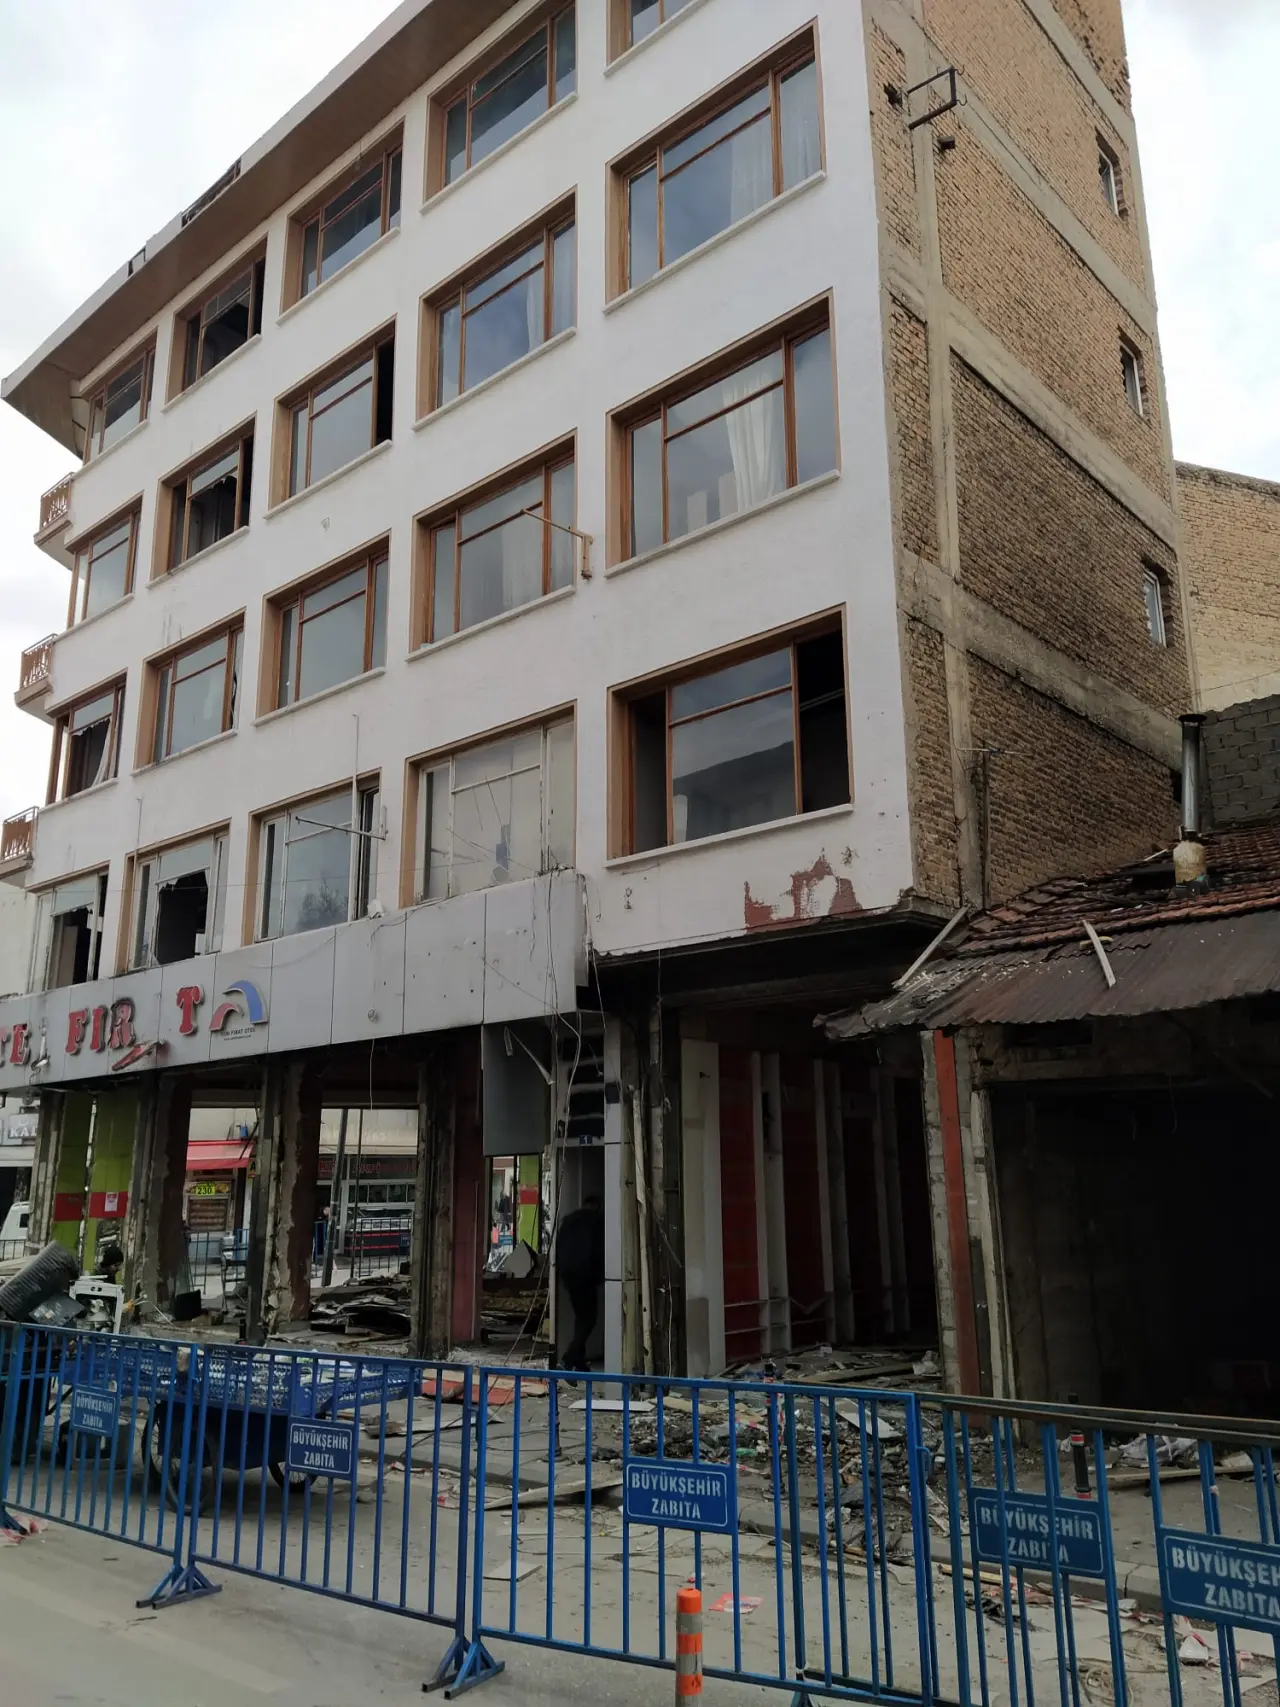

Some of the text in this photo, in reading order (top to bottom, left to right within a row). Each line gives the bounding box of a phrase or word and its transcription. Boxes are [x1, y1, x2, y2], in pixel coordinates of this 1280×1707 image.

[293, 1428, 349, 1451] BÜYÜKŞEHİR
[303, 1451, 335, 1468] ZABITA
[631, 1470, 722, 1498] BÜYÜKŞEHİR
[651, 1498, 701, 1519] ZABITA
[1007, 1537, 1070, 1564] ZABIA
[1204, 1583, 1280, 1618] ZABITA
